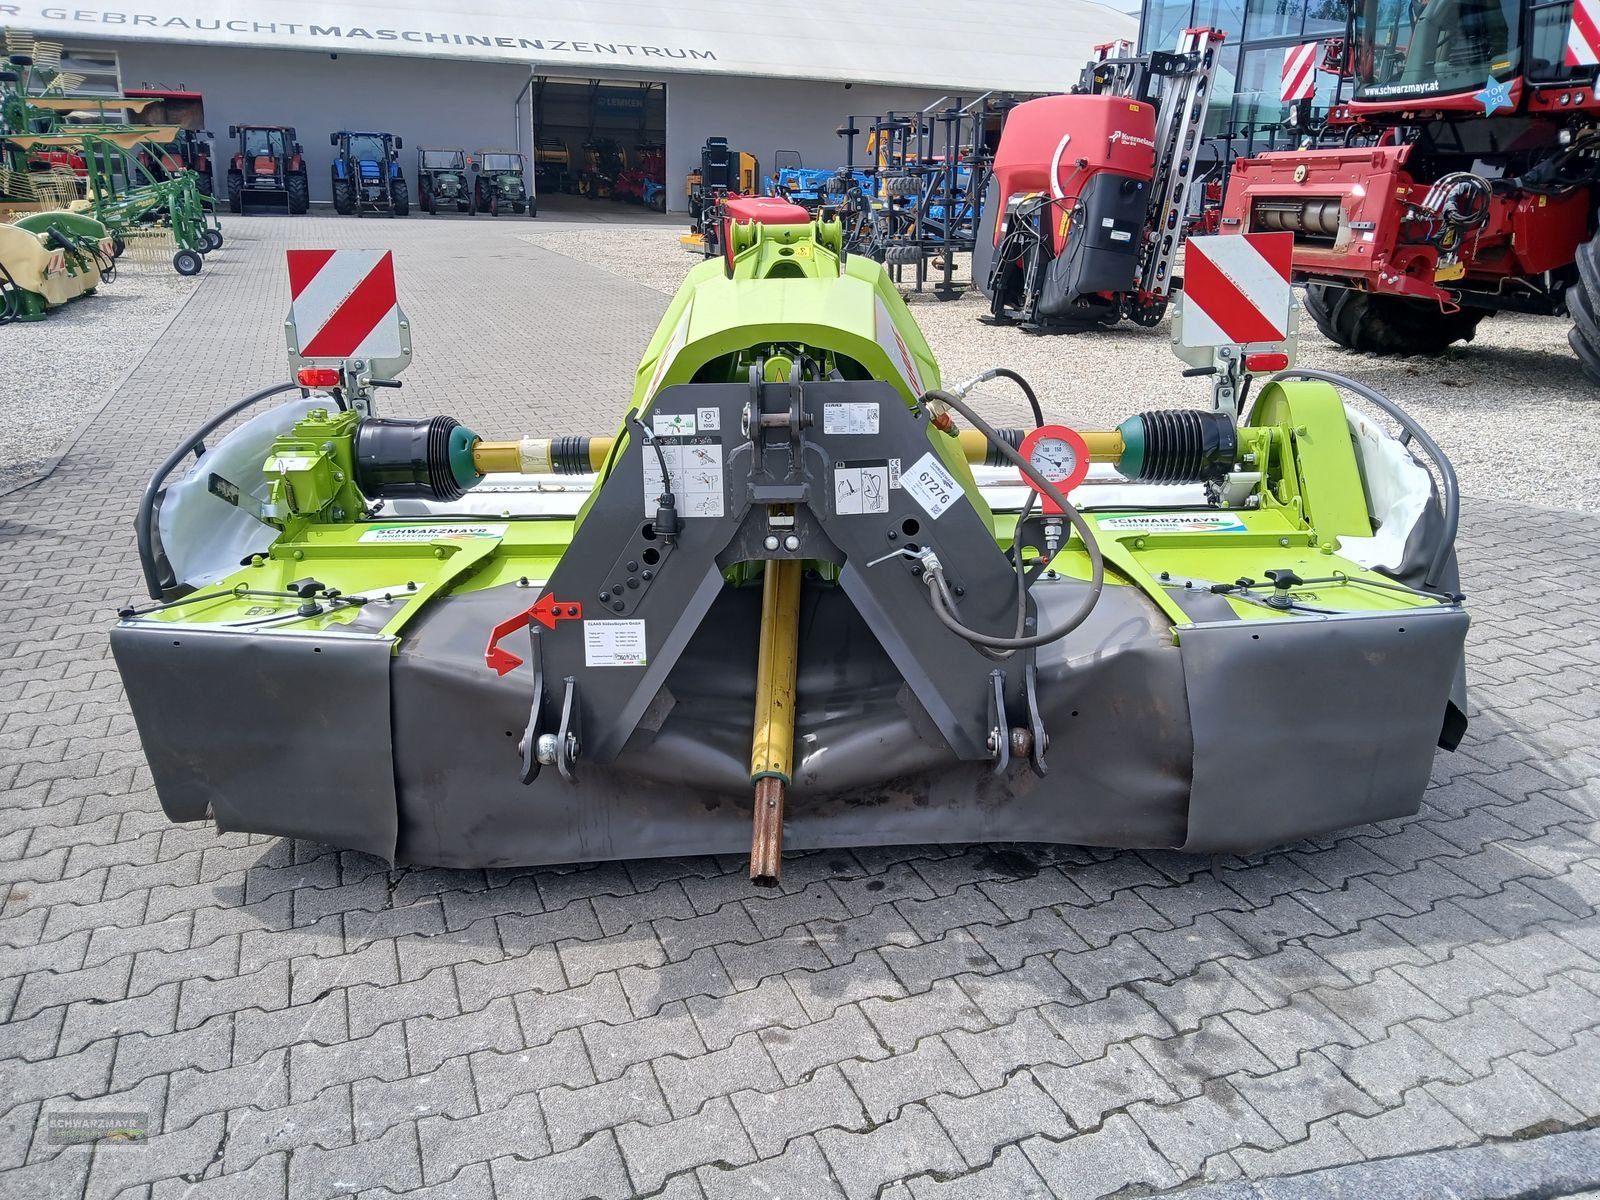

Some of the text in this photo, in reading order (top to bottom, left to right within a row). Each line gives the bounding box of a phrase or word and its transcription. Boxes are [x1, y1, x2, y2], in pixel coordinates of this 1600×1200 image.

[41, 7, 718, 61] GEBRAUCHTMASCHINENZENTRUM
[1364, 80, 1439, 96] www.schwarzmayr.at
[1485, 85, 1505, 98] TOP
[607, 97, 643, 108] LEMKEN
[1491, 94, 1504, 106] 20
[1121, 132, 1155, 148] Kverneland
[919, 471, 951, 505] 67276
